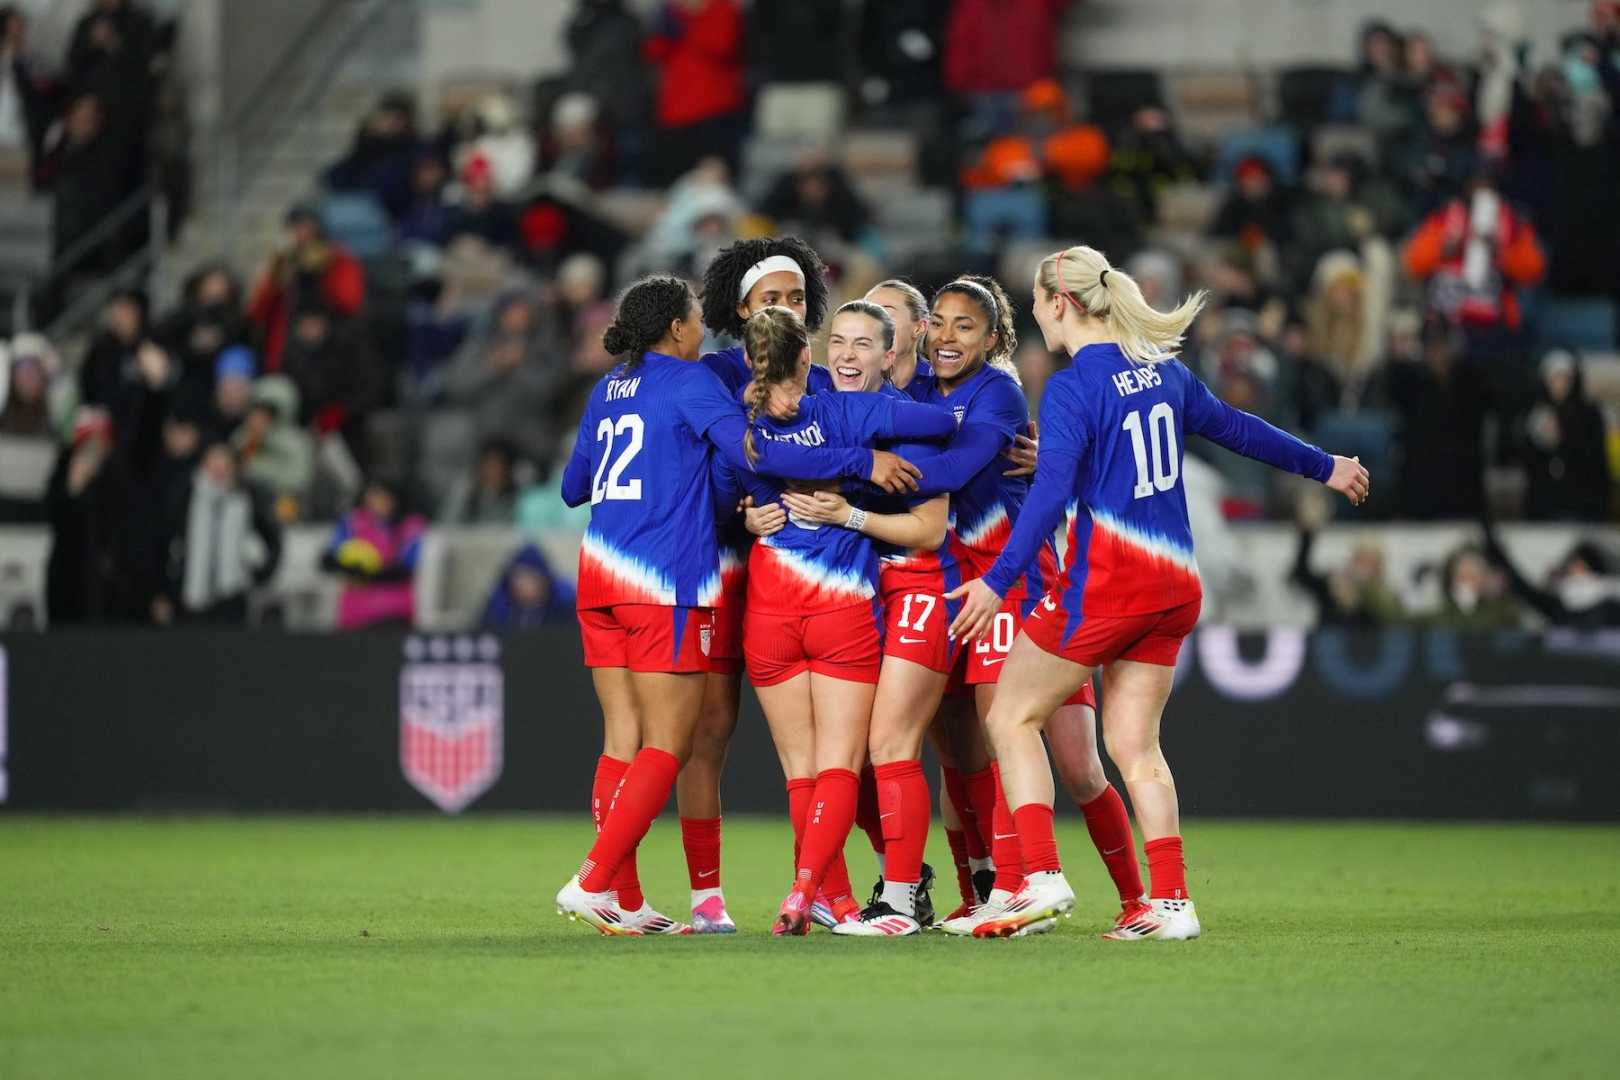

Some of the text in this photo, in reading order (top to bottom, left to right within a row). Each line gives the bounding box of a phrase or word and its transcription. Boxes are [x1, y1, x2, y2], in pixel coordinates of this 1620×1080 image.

[605, 376, 641, 402] RYAN
[1112, 365, 1163, 397] HEAPS
[591, 413, 645, 506] 22
[1122, 402, 1179, 500] 10
[897, 595, 937, 632] 17
[812, 801, 825, 825] USA
